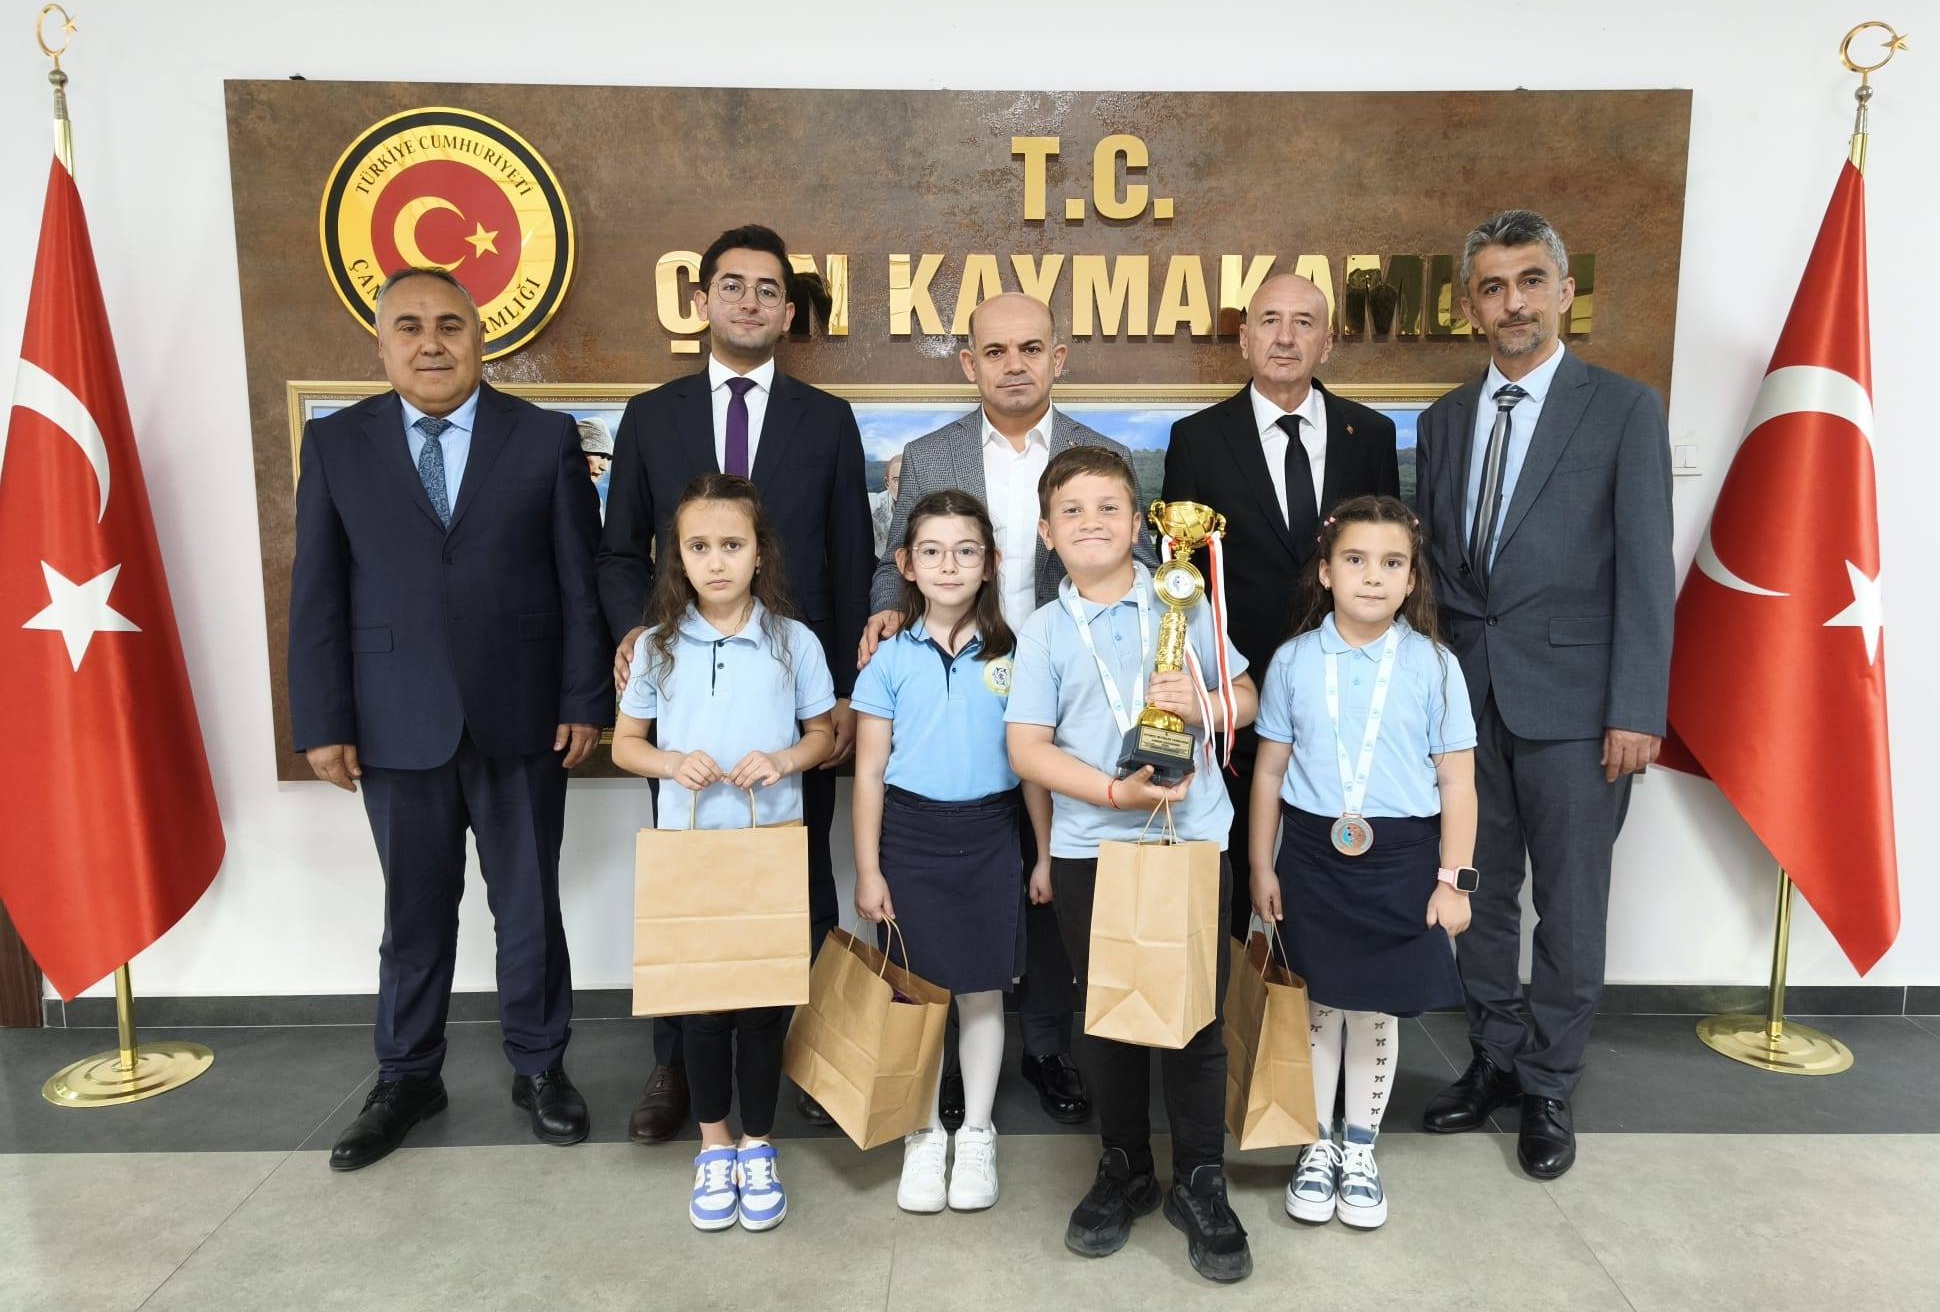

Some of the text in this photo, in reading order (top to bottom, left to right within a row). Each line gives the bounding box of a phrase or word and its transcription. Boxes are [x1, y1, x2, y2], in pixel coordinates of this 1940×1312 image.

[355, 134, 534, 197] TÜRKİYE CUMHURİYETİ
[1011, 134, 1174, 221] T.C.
[655, 250, 849, 354] ÇN
